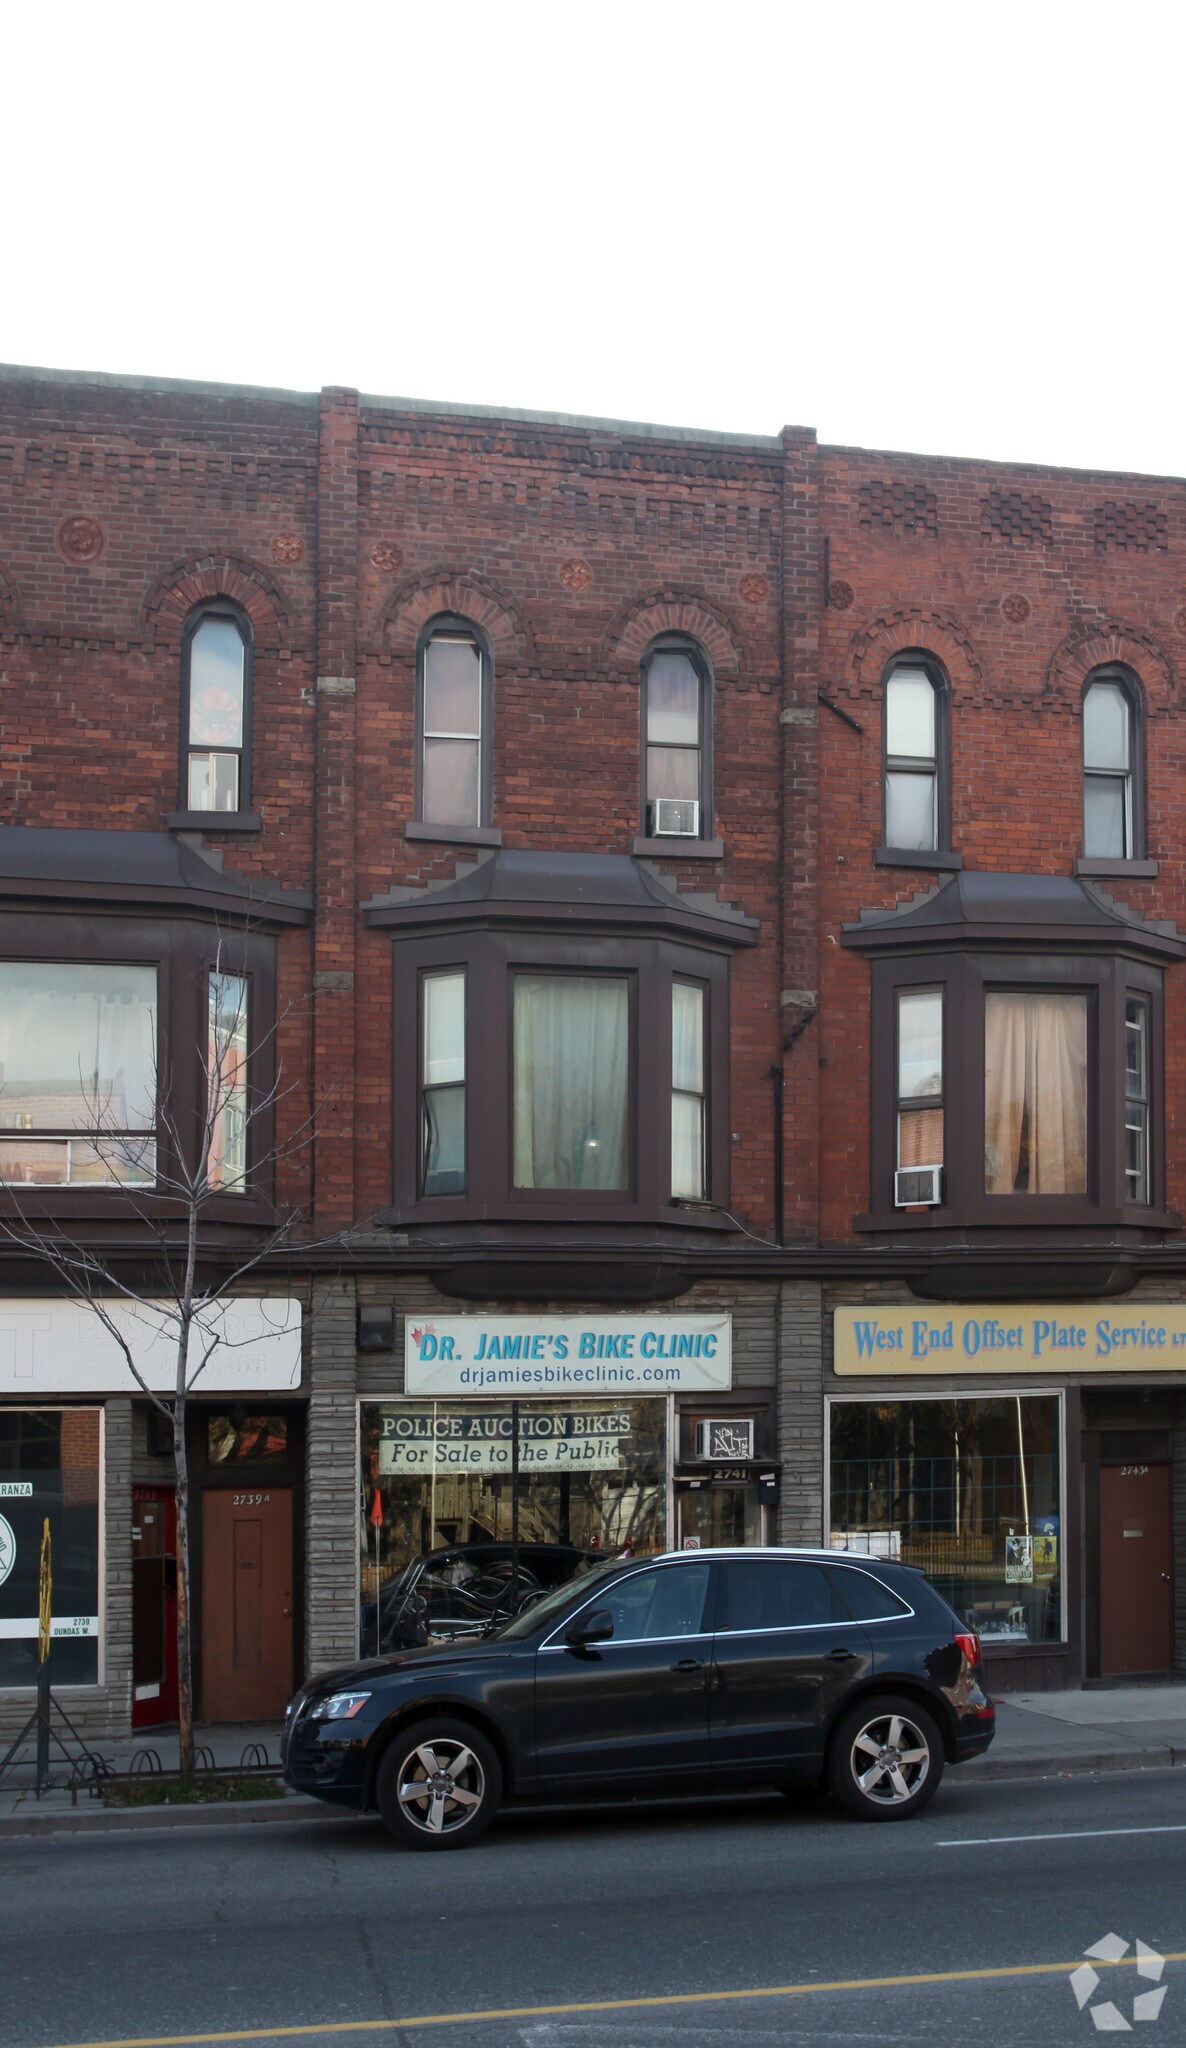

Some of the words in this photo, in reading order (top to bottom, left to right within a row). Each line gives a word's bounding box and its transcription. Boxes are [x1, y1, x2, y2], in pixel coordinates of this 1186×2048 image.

[419, 1333, 462, 1361] DR.
[473, 1333, 569, 1361] JAMIE'S
[578, 1332, 635, 1359] BIKE
[639, 1331, 718, 1359] CLINIC
[853, 1321, 904, 1358] West
[911, 1320, 954, 1357] End
[962, 1319, 1024, 1357] Offset
[1032, 1320, 1087, 1356] Plate
[1096, 1319, 1167, 1355] Service
[460, 1365, 681, 1386] drjamiesbikeclinic.com
[382, 1417, 463, 1437] POLICE
[467, 1417, 567, 1437] AUCTION
[572, 1414, 631, 1435] BIKES
[391, 1443, 429, 1463] For
[435, 1443, 482, 1463] Sale
[489, 1445, 508, 1463] to
[555, 1440, 620, 1461] Public
[713, 1468, 746, 1479] 2741
[0, 1484, 31, 1496] RANZA
[54, 1627, 80, 1636] DUNDAS
[81, 1626, 90, 1635] W.
[73, 1618, 90, 1626] 2739
